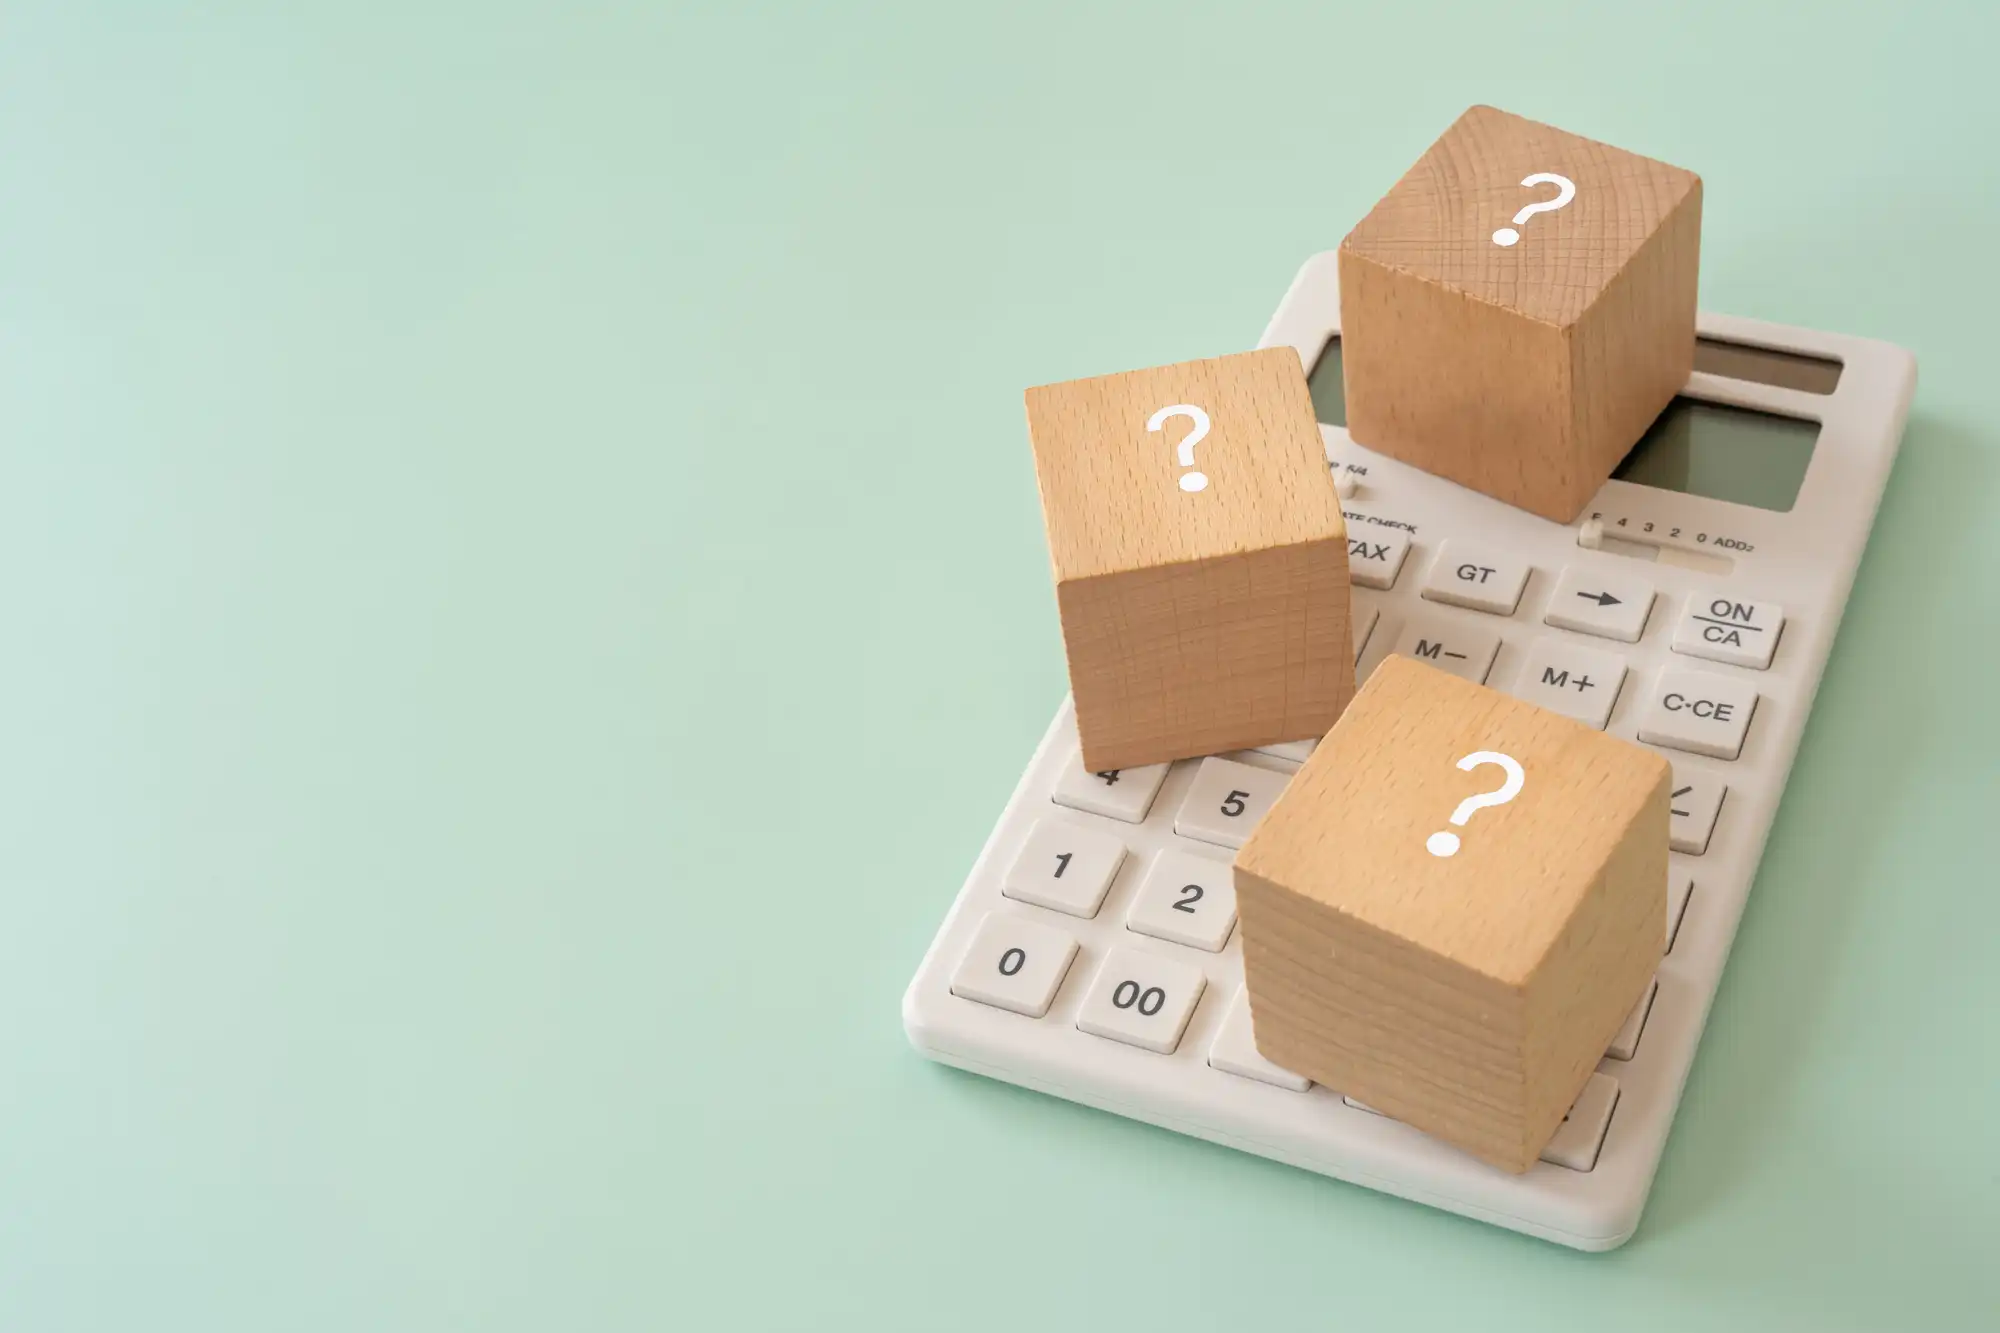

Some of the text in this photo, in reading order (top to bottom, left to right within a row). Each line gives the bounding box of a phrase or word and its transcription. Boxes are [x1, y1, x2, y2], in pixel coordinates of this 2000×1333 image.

[1492, 172, 1576, 247] ?
[1147, 404, 1211, 492] ?
[1367, 516, 1418, 535] CHECK
[1617, 517, 1628, 528] 4
[1643, 522, 1655, 533] 3
[1669, 527, 1681, 538] 2
[1456, 564, 1496, 584] GT
[1710, 599, 1754, 622] ON
[1703, 626, 1741, 647] CA
[1541, 667, 1595, 692] M+
[1220, 790, 1250, 817] 5
[1426, 750, 1525, 858] ?
[1054, 852, 1073, 878] 1
[1172, 884, 1204, 914] 2
[998, 948, 1026, 976] 0
[1112, 980, 1166, 1016] 00
